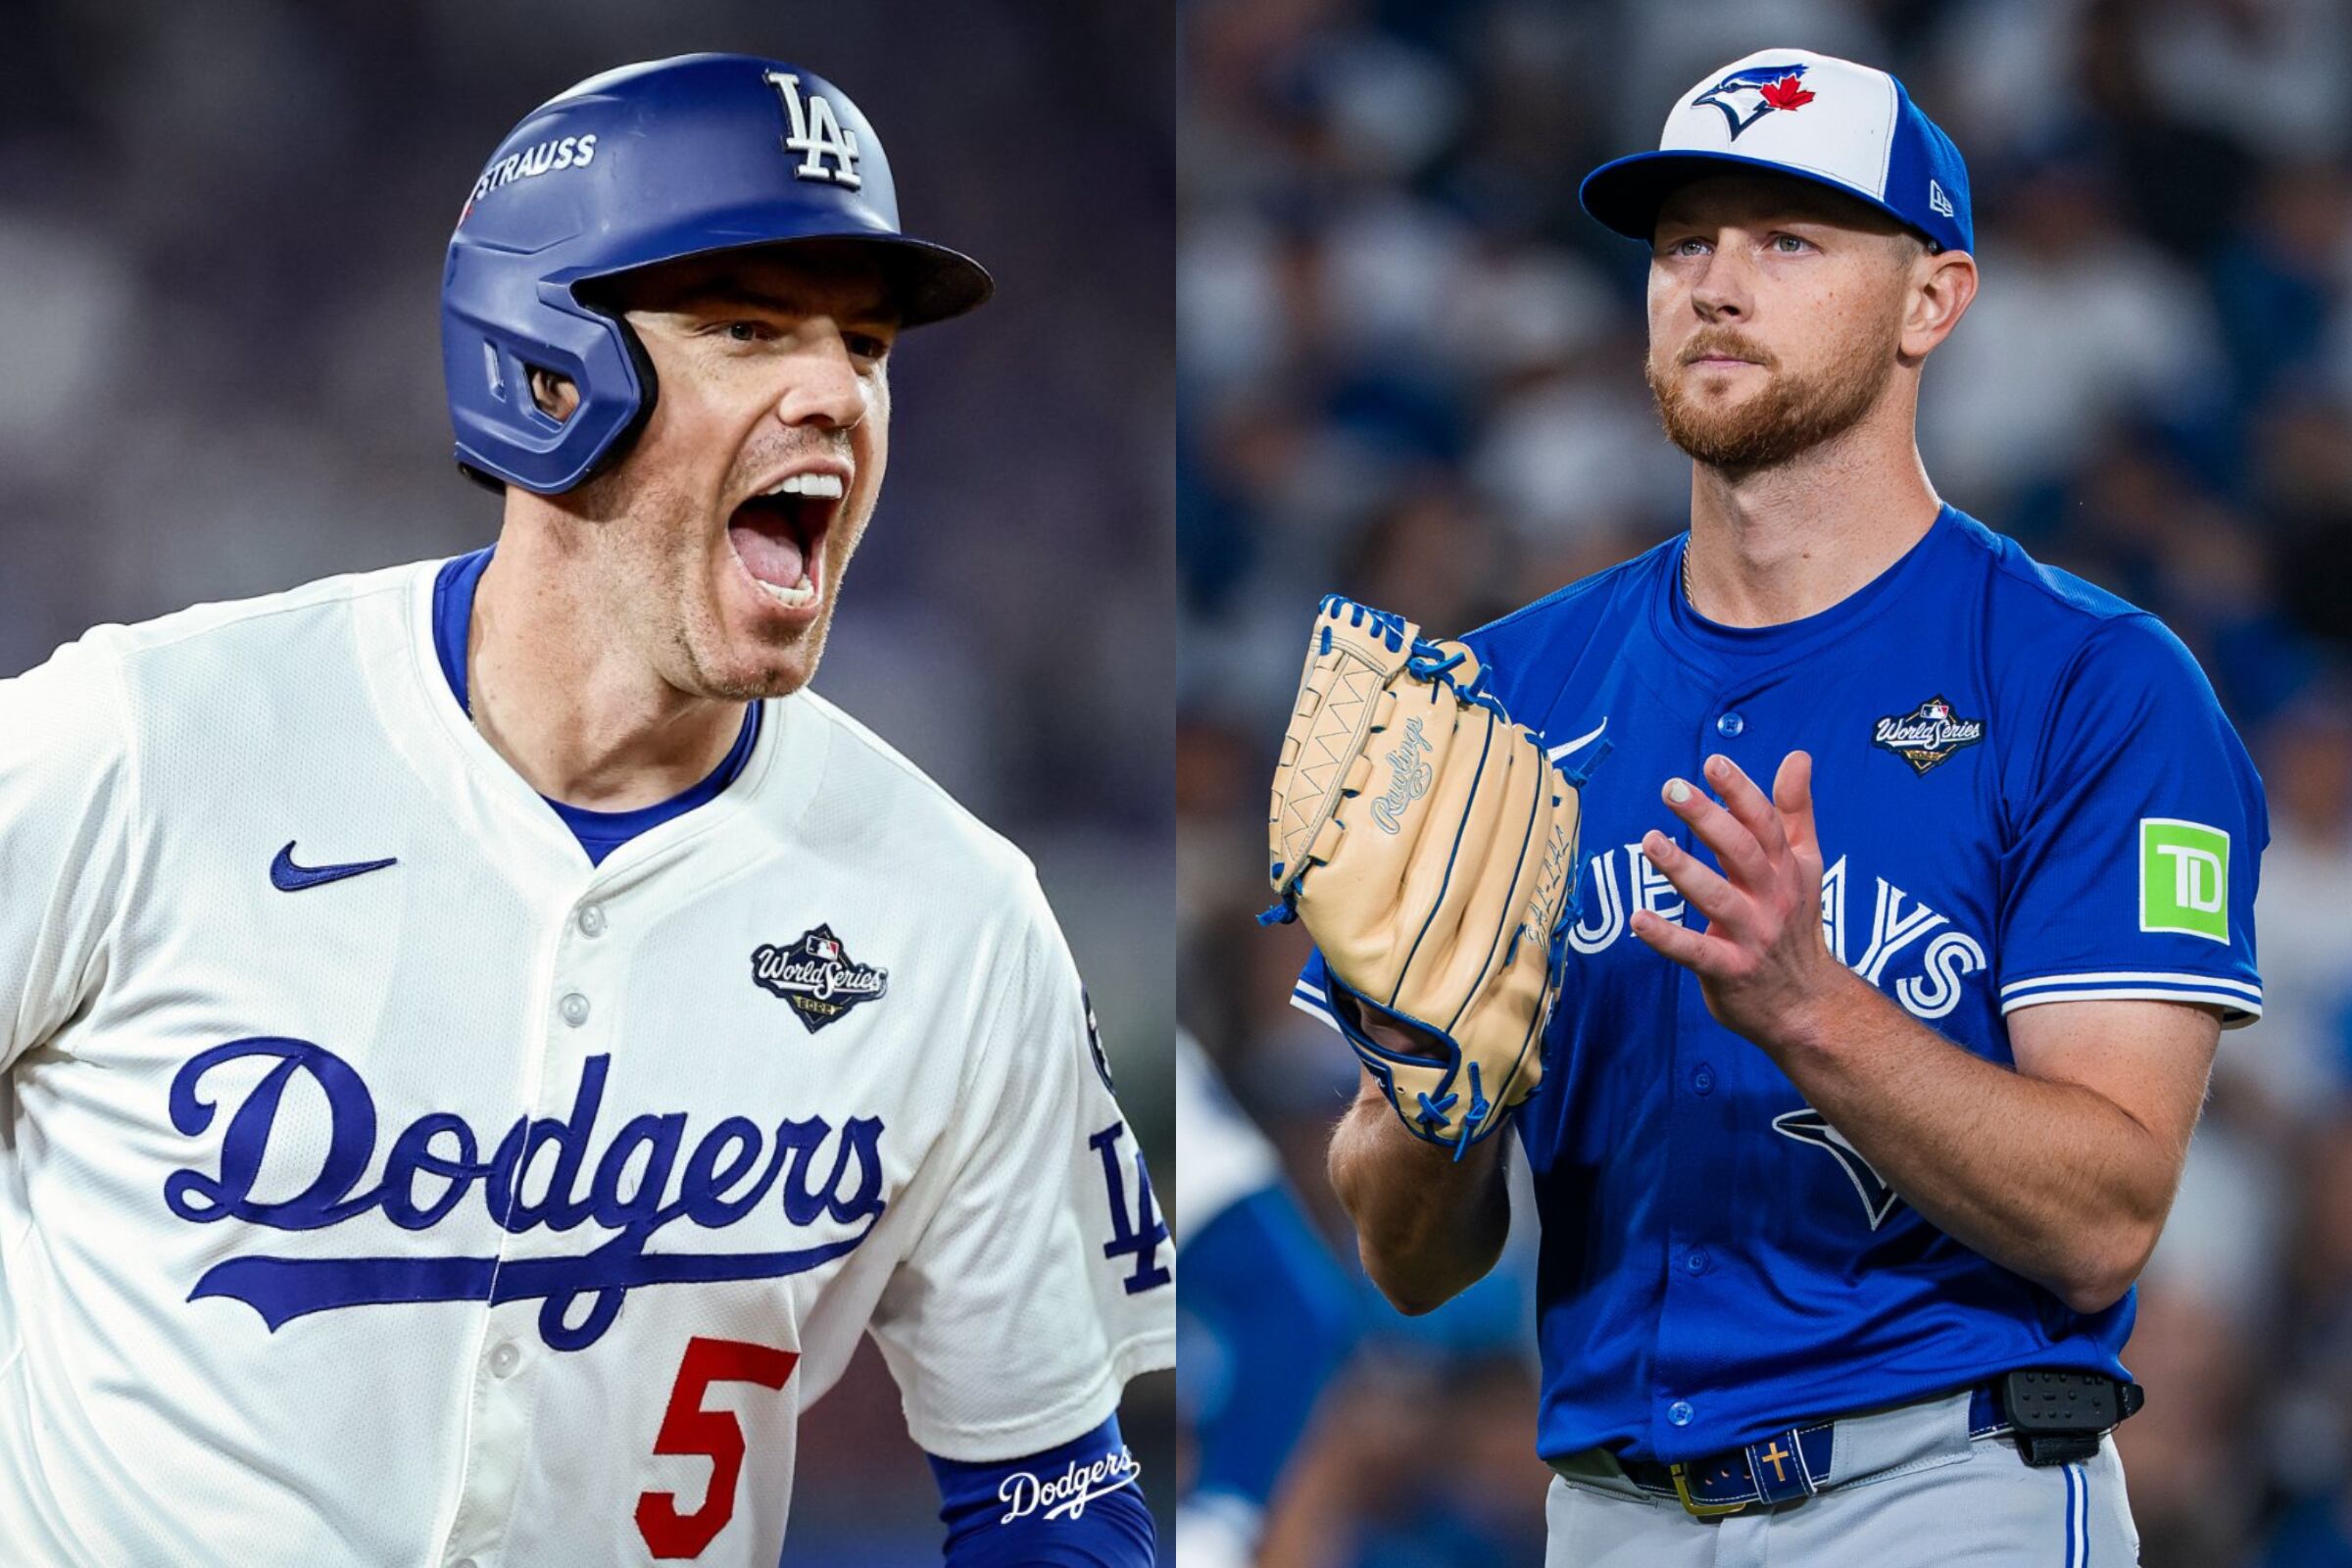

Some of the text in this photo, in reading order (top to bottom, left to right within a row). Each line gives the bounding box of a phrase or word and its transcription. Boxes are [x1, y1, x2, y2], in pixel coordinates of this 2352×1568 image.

[474, 133, 598, 200] STRAUSS
[768, 73, 861, 186] LA
[1876, 717, 1982, 751] World Series
[1370, 715, 1434, 835] Rawlings
[2157, 844, 2224, 913] TD
[757, 947, 885, 1001] World Series
[163, 1036, 888, 1353] Dodgers
[633, 1336, 802, 1560] 5
[998, 1445, 1142, 1526] Dodgers
